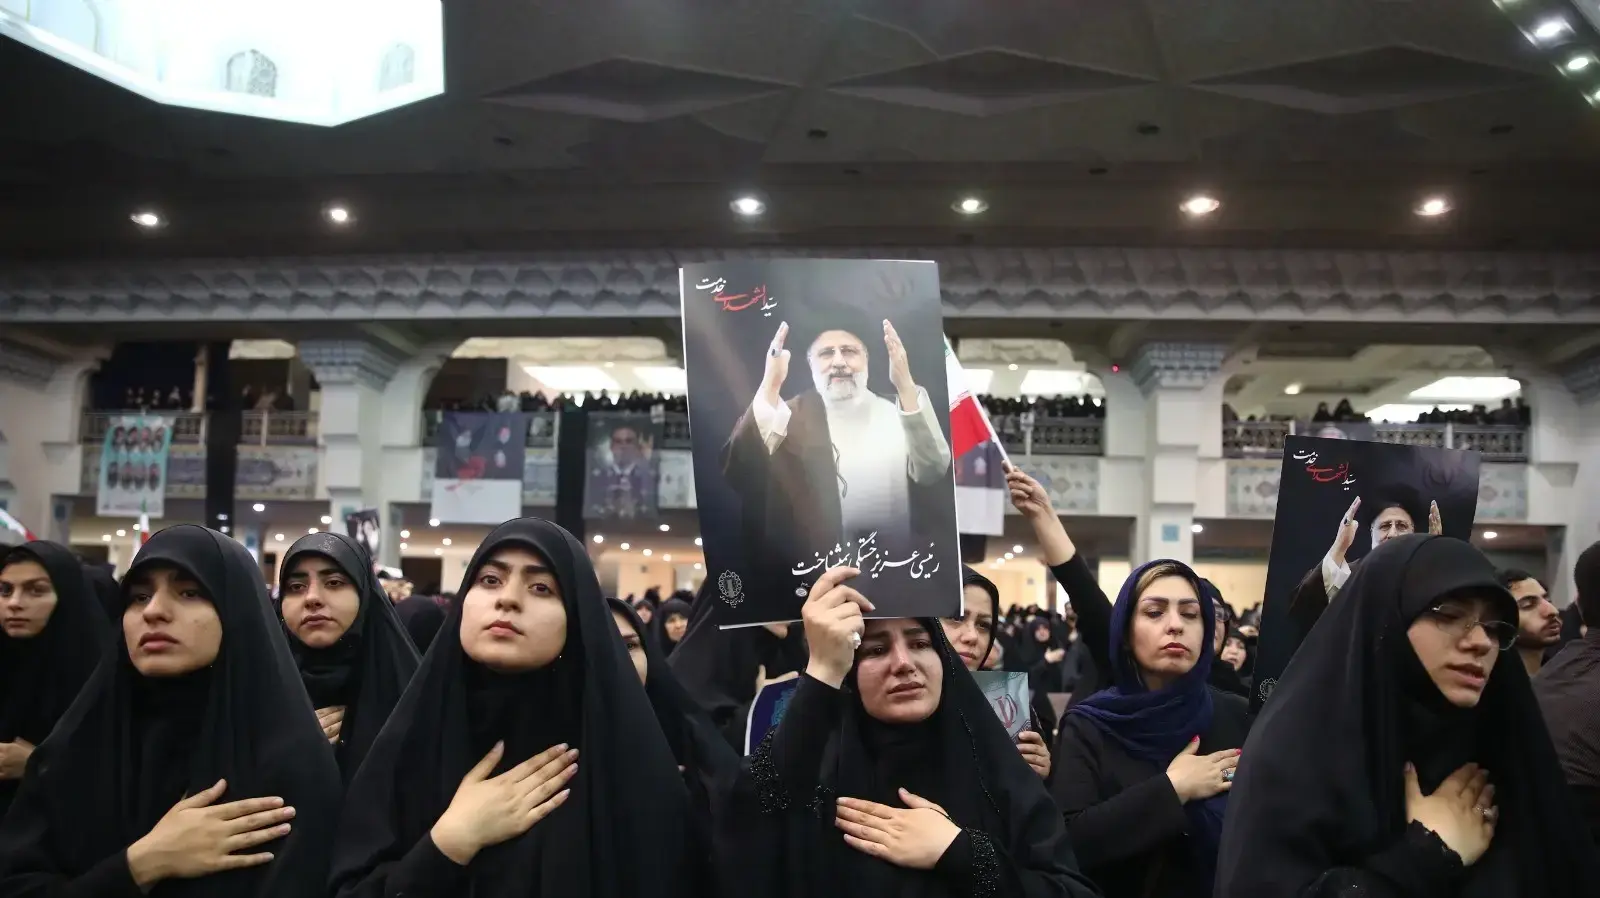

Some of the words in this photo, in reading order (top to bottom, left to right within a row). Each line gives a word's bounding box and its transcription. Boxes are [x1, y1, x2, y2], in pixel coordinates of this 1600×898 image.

[695, 277, 727, 294] خدمت
[1292, 450, 1319, 464] خدمت
[869, 550, 920, 579] عزیز
